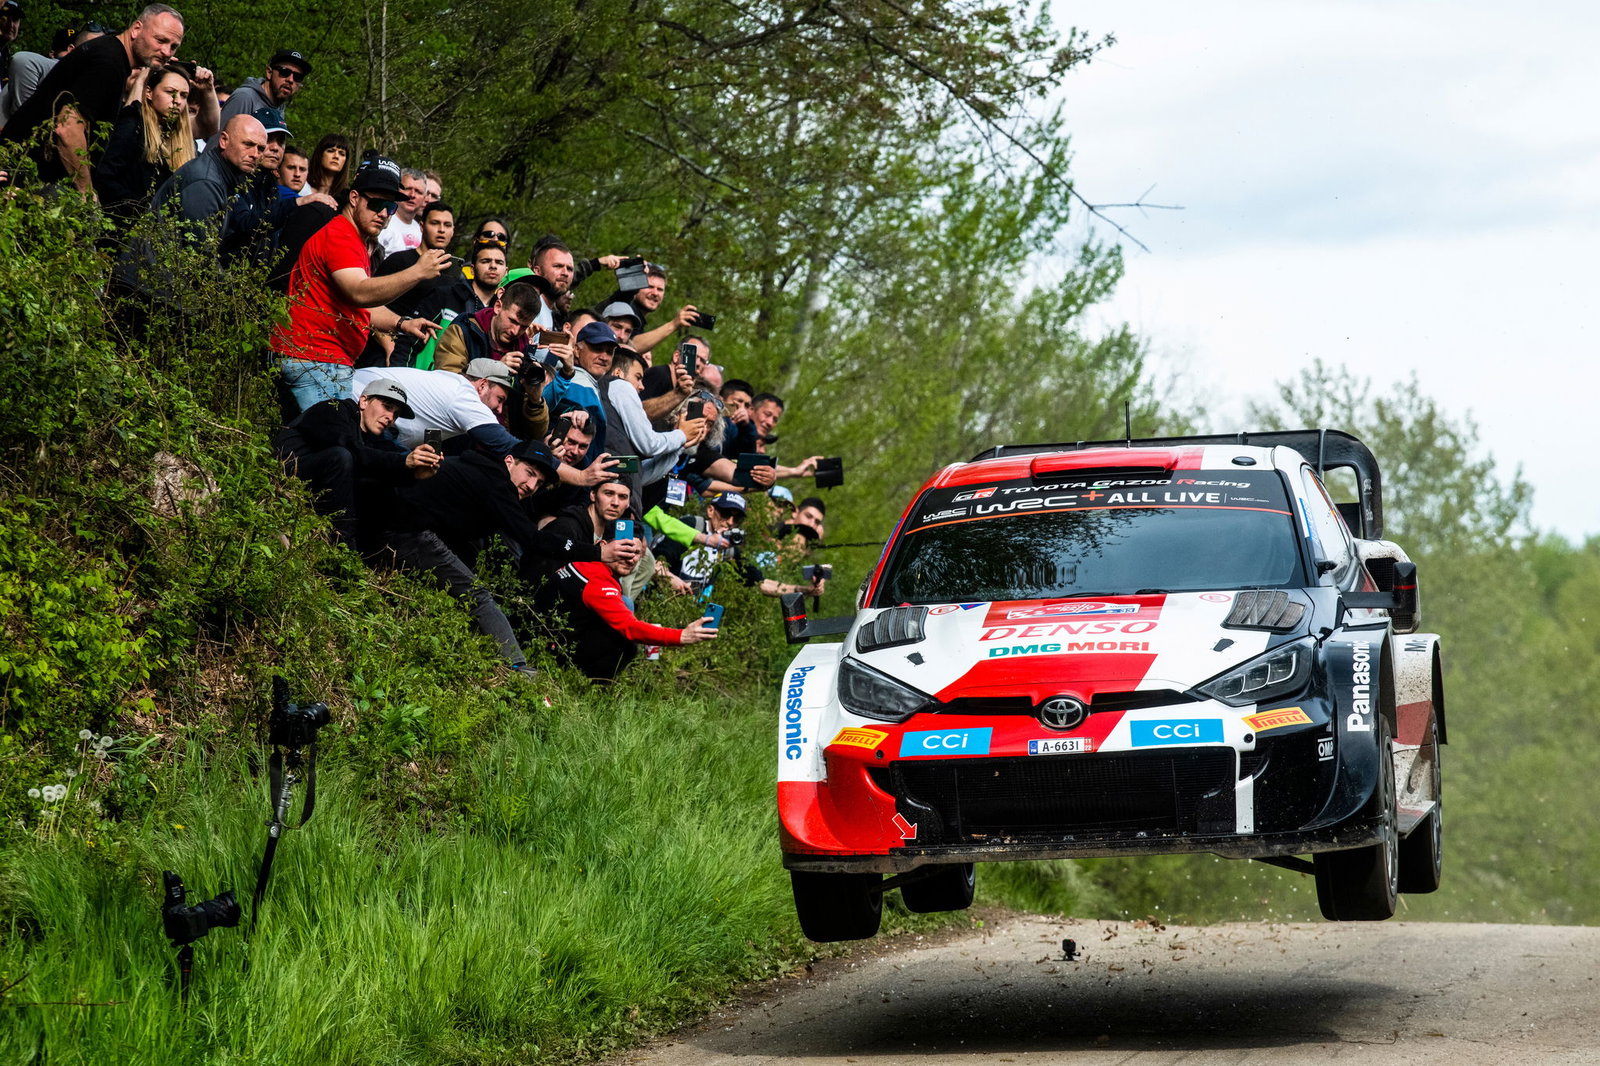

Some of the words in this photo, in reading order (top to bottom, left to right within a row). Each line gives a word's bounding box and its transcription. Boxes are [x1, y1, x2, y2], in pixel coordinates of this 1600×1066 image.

[1001, 482, 1087, 495] TOYOTA
[1092, 479, 1172, 487] GAZOO
[1176, 478, 1251, 489] Racing
[1107, 492, 1156, 504] ALL
[1164, 492, 1220, 504] LIVE
[978, 621, 1158, 641] DENSO
[989, 643, 1062, 657] DMG
[1067, 641, 1150, 652] MORI
[786, 665, 816, 761] Panasonic
[1249, 710, 1306, 728] PIRELLI
[835, 729, 881, 746] PIRELLI
[1318, 741, 1333, 757] OMP
